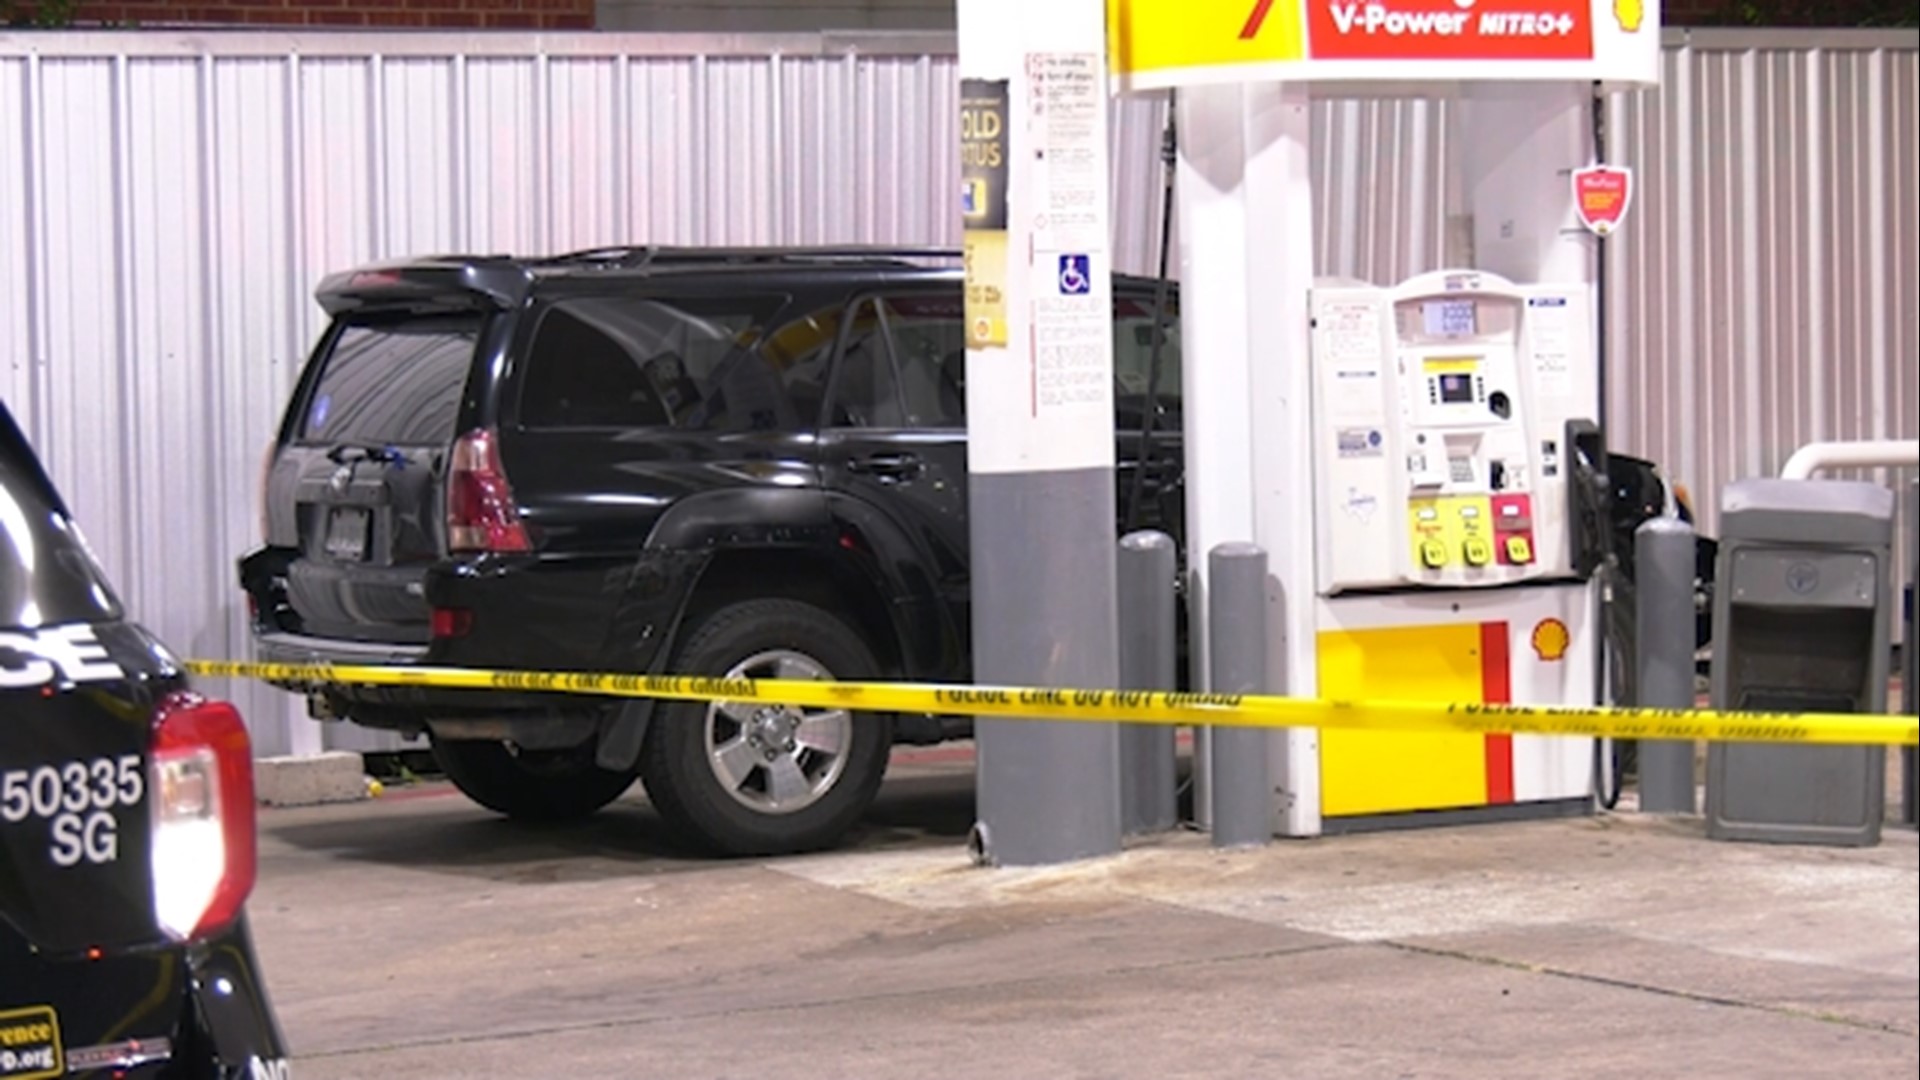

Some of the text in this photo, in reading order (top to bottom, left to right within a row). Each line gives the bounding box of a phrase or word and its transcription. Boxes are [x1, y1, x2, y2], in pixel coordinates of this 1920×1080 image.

[1329, 4, 1573, 36] V-Power NITRO+
[1, 754, 143, 821] 50335
[50, 811, 118, 867] SG
